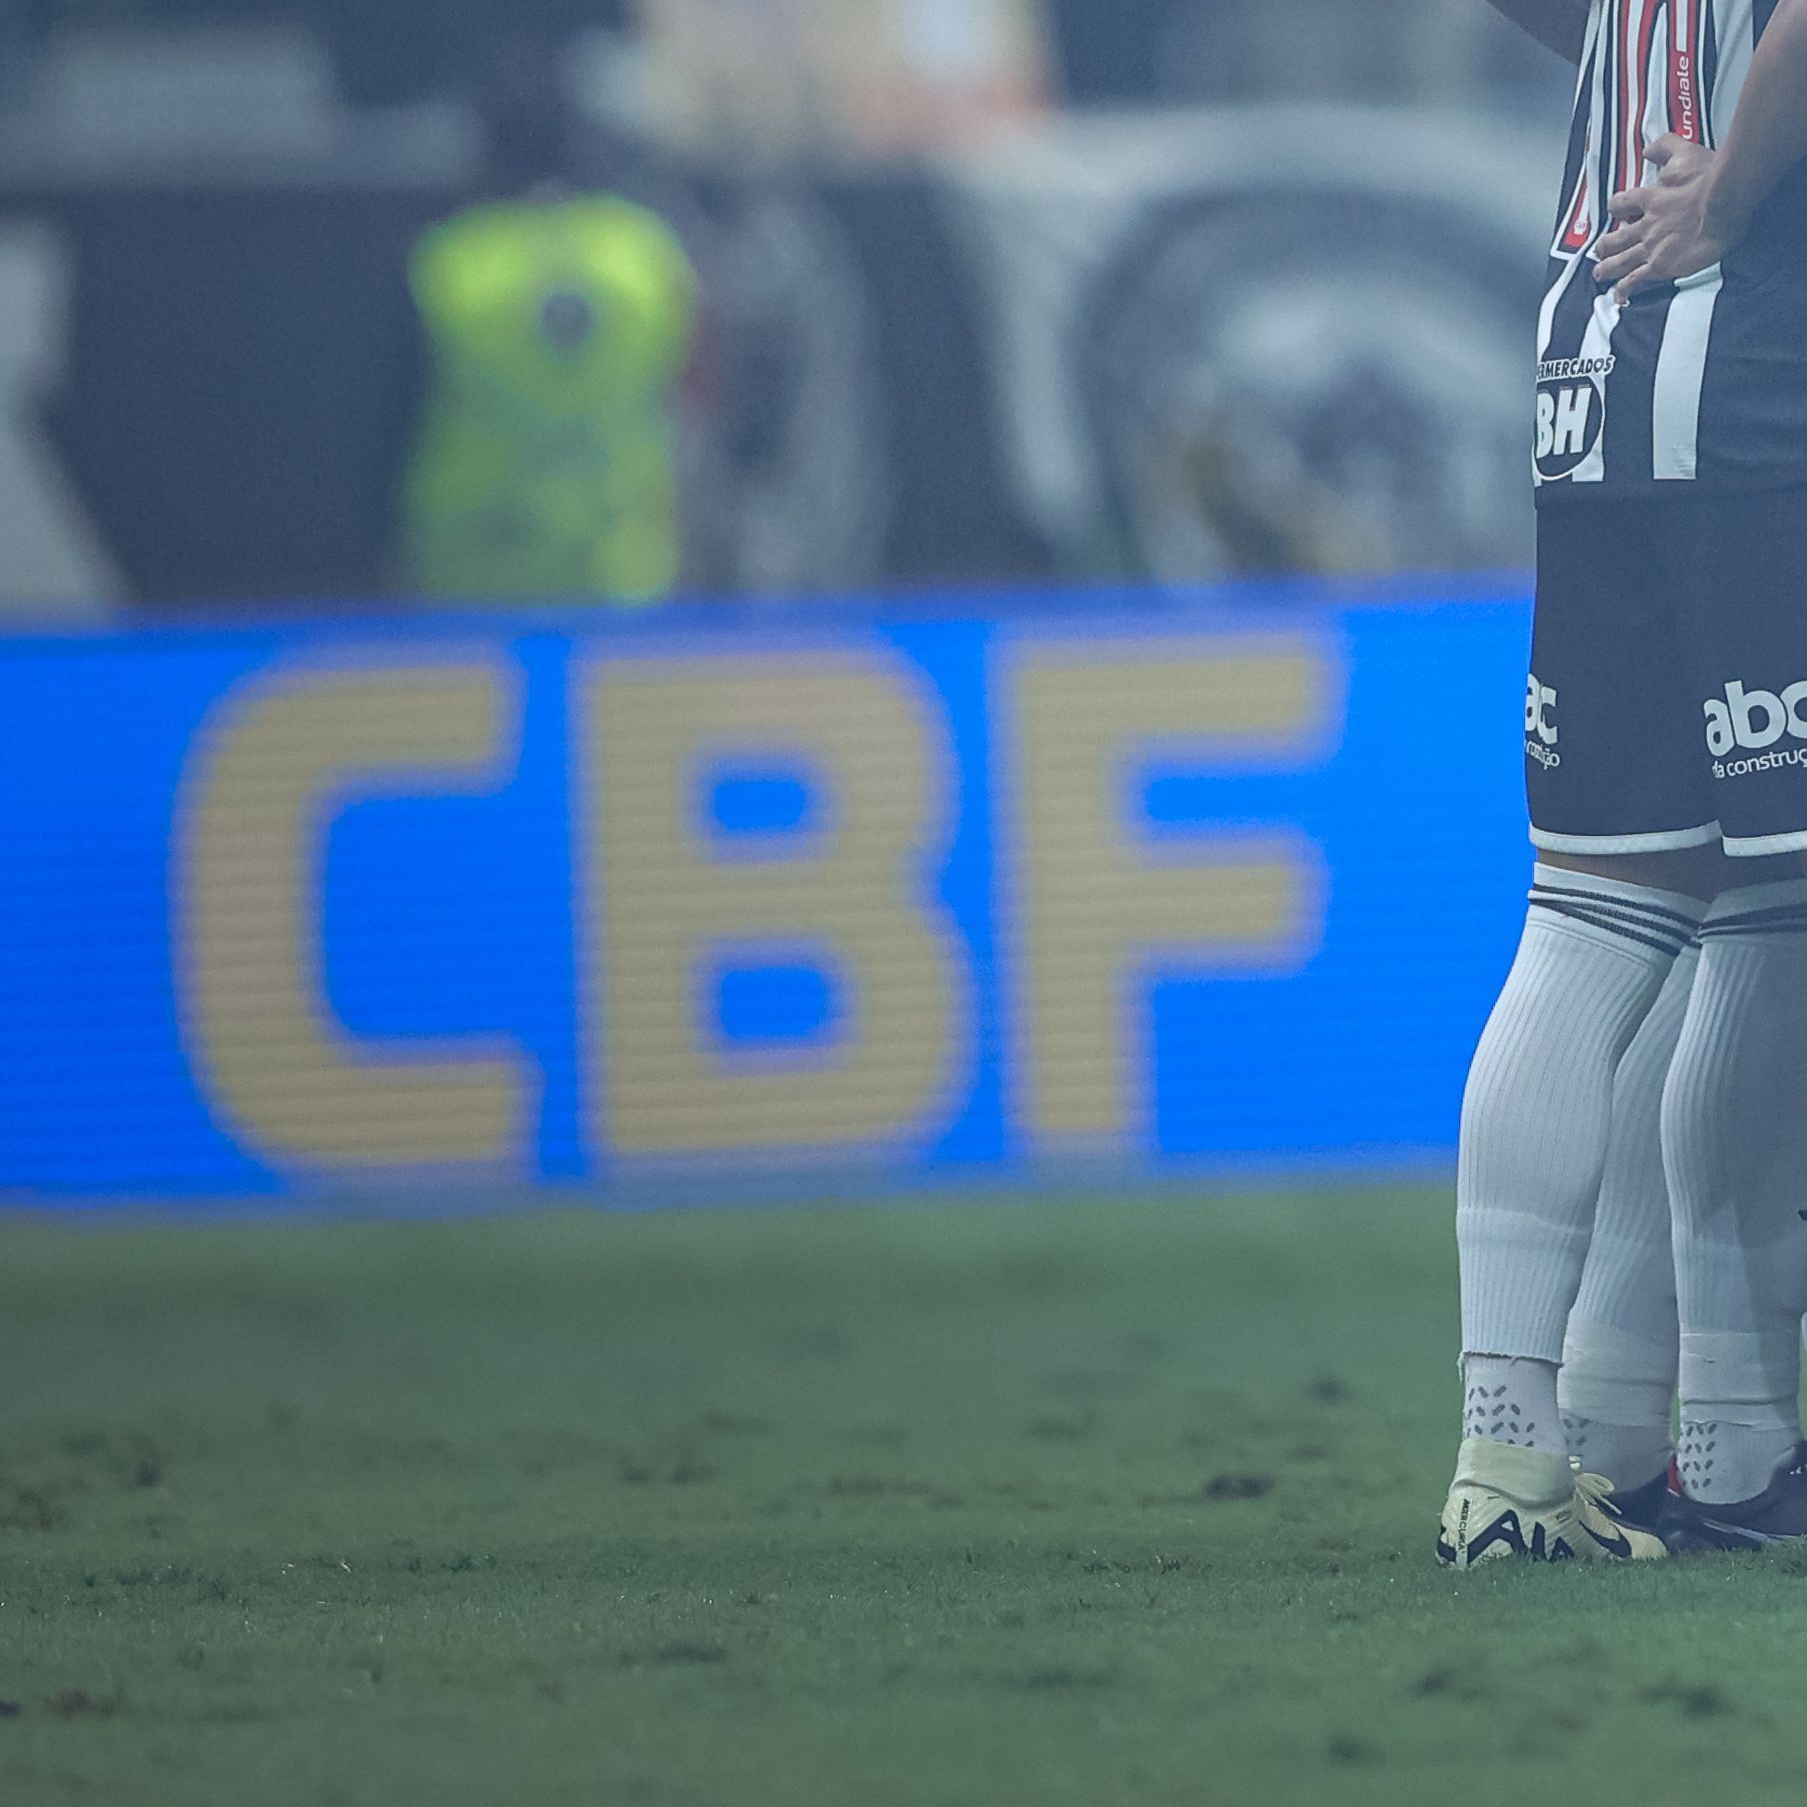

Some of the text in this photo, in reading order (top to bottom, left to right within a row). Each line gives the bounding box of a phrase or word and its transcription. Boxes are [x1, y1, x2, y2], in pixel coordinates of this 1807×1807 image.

[1676, 55, 1694, 140] undiale
[1536, 386, 1593, 460] BH
[180, 643, 1325, 1178] CBF
